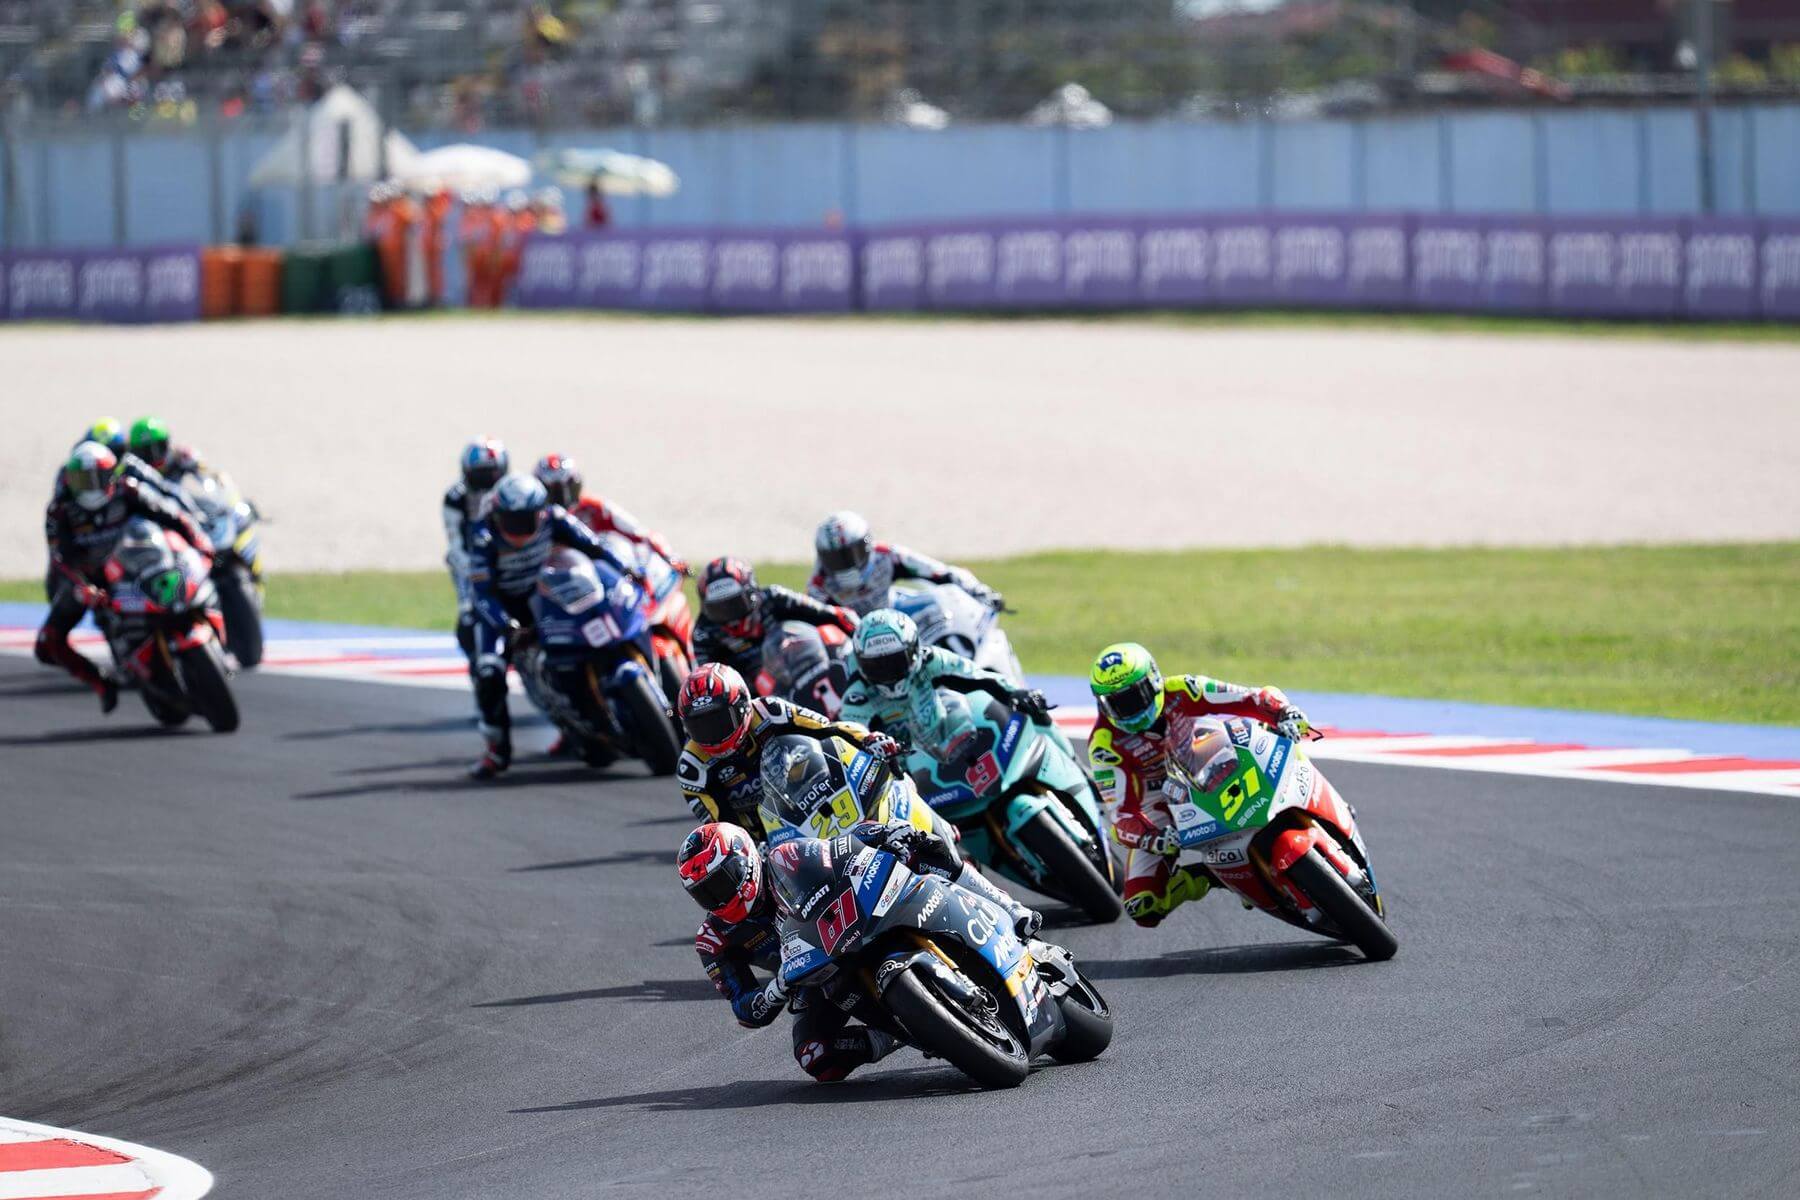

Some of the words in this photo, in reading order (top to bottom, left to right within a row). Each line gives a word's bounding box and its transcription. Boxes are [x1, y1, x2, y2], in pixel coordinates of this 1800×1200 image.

[867, 636, 896, 648] AIROH
[799, 779, 831, 811] brofer
[1220, 766, 1261, 822] 51
[810, 789, 860, 840] 29
[1237, 797, 1269, 828] SENA
[801, 884, 831, 919] DUCATI
[816, 886, 859, 957] 61
[840, 929, 861, 953] aruba.it
